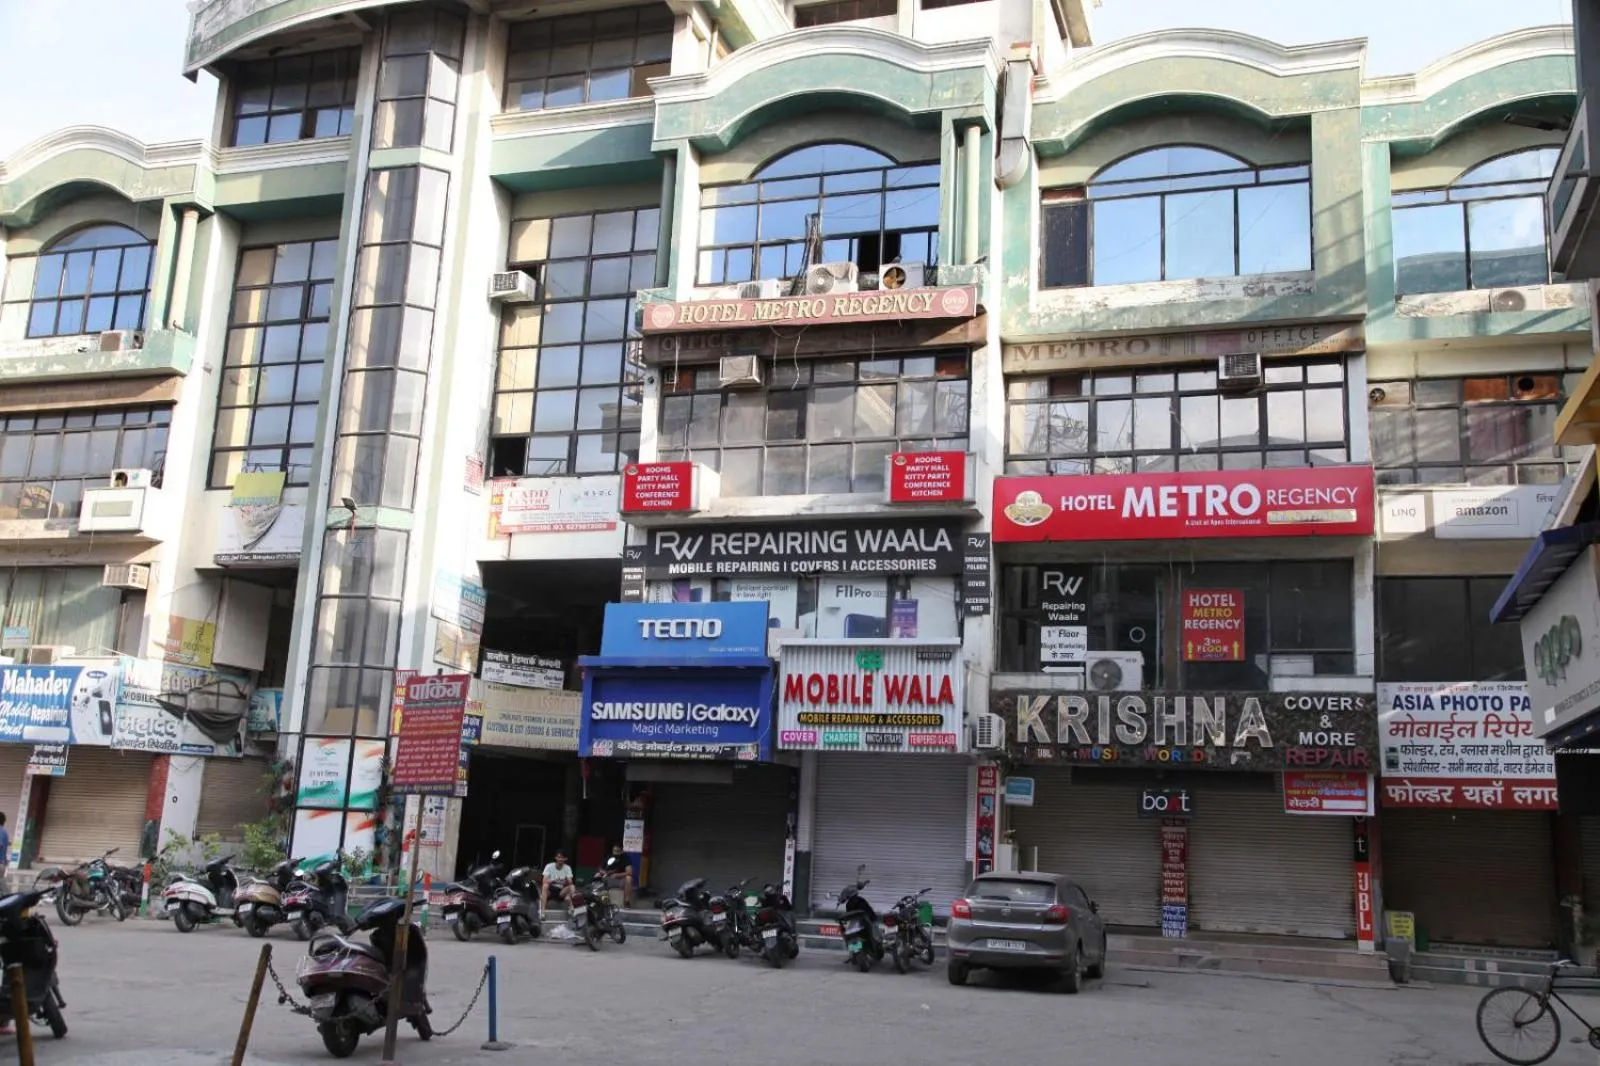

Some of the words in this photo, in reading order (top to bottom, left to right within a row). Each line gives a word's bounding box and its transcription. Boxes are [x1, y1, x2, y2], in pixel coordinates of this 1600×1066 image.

[678, 303, 747, 323] HOTEL
[751, 299, 827, 321] METRO
[831, 292, 937, 317] REGENCY
[1248, 326, 1320, 344] OFFICE
[1013, 338, 1150, 362] METRO
[635, 491, 680, 499] CONFERENCE
[1060, 495, 1116, 511] HOTEL
[1121, 483, 1261, 519] METRO
[1266, 487, 1358, 505] REGENCY
[1456, 506, 1508, 517] amazon
[710, 530, 847, 556] REPAIRING
[854, 529, 953, 552] WAALA
[668, 563, 713, 574] MOBILE
[716, 561, 779, 574] REPAIRING
[791, 560, 839, 572] COVERS
[850, 559, 937, 571] ACCESSORIES
[854, 588, 872, 598] Pro
[1189, 594, 1236, 607] HOTEL
[1042, 602, 1086, 612] Repairing
[1193, 607, 1233, 618] METRO
[1047, 612, 1079, 621] Waala
[1184, 619, 1241, 629] REGENCY
[638, 618, 722, 638] TECNO
[1058, 629, 1080, 638] Floor
[2, 669, 72, 694] Mahadev
[783, 673, 874, 706] MOBILE
[884, 674, 954, 705] WALA
[1392, 695, 1434, 711] ASIA
[1441, 695, 1503, 712] PHOTO
[31, 704, 69, 726] Repairing
[592, 702, 684, 720] SAMSUNG
[692, 703, 760, 728] Galaxy
[799, 713, 831, 724] MOBILE
[832, 714, 876, 724] REPAIRING
[878, 715, 884, 724] &
[887, 715, 941, 725] ACCESSORIES
[1016, 695, 1273, 748] KRISHNA
[1319, 714, 1332, 729] &
[632, 722, 663, 735] Magic
[665, 723, 719, 737] Marketing
[1389, 713, 1477, 743] मोबाईल
[783, 732, 814, 742] COVER
[1299, 732, 1356, 746] MORE
[1286, 747, 1369, 767] REPAIR
[1490, 740, 1520, 755] मशीन
[1522, 744, 1544, 759] द्वारा
[1385, 780, 1455, 803] फोल्डर
